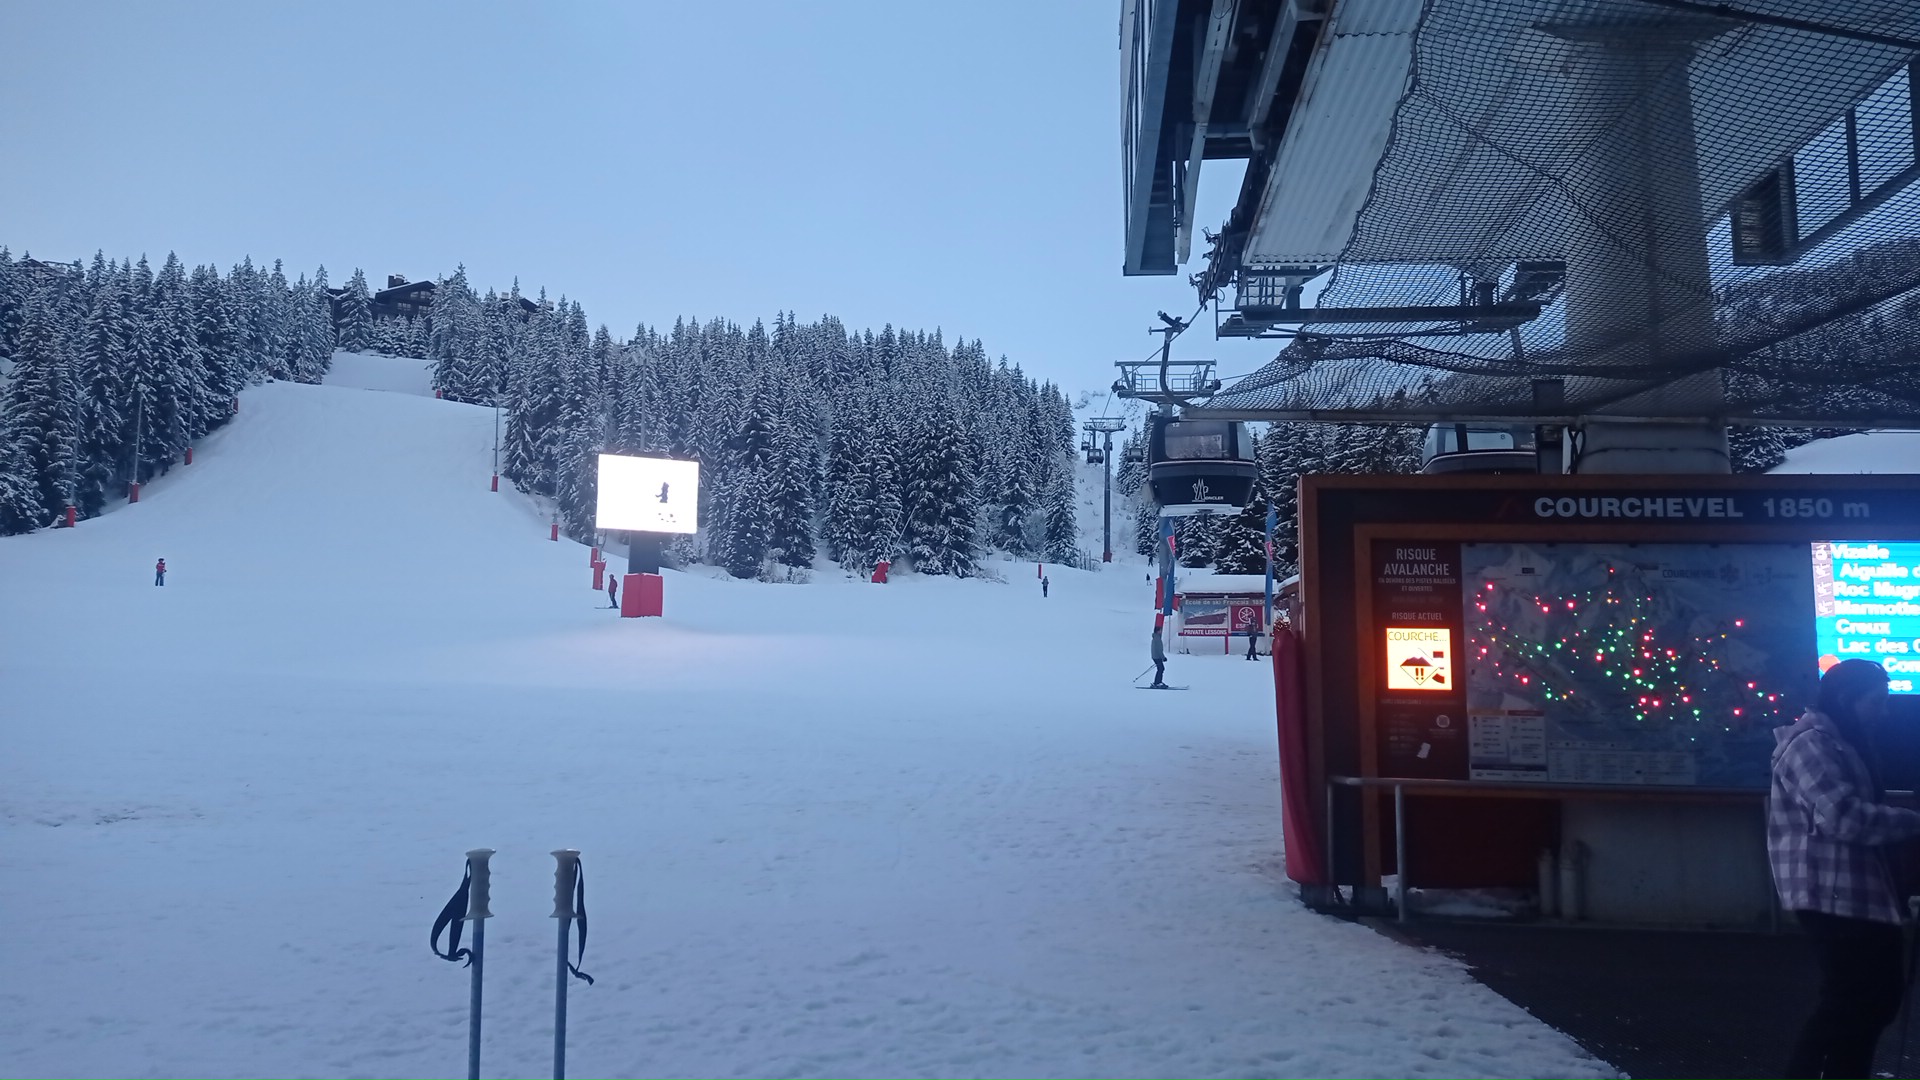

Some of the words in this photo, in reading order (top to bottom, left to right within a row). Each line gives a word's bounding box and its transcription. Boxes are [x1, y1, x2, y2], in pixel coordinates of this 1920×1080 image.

[1534, 497, 1743, 518] COURCHEVEL
[1763, 497, 1833, 518] 1850
[1842, 501, 1871, 518] m
[1396, 549, 1437, 560] RISQUE
[1384, 563, 1449, 575] AVALANCHE
[1840, 563, 1908, 581] Aiguille
[1834, 580, 1870, 597] Roc
[1392, 612, 1416, 620] RISQUE
[1418, 612, 1442, 620] ACTUEL
[1836, 618, 1891, 635] Creux
[1837, 637, 1871, 654] Lac
[1874, 637, 1909, 654] des
